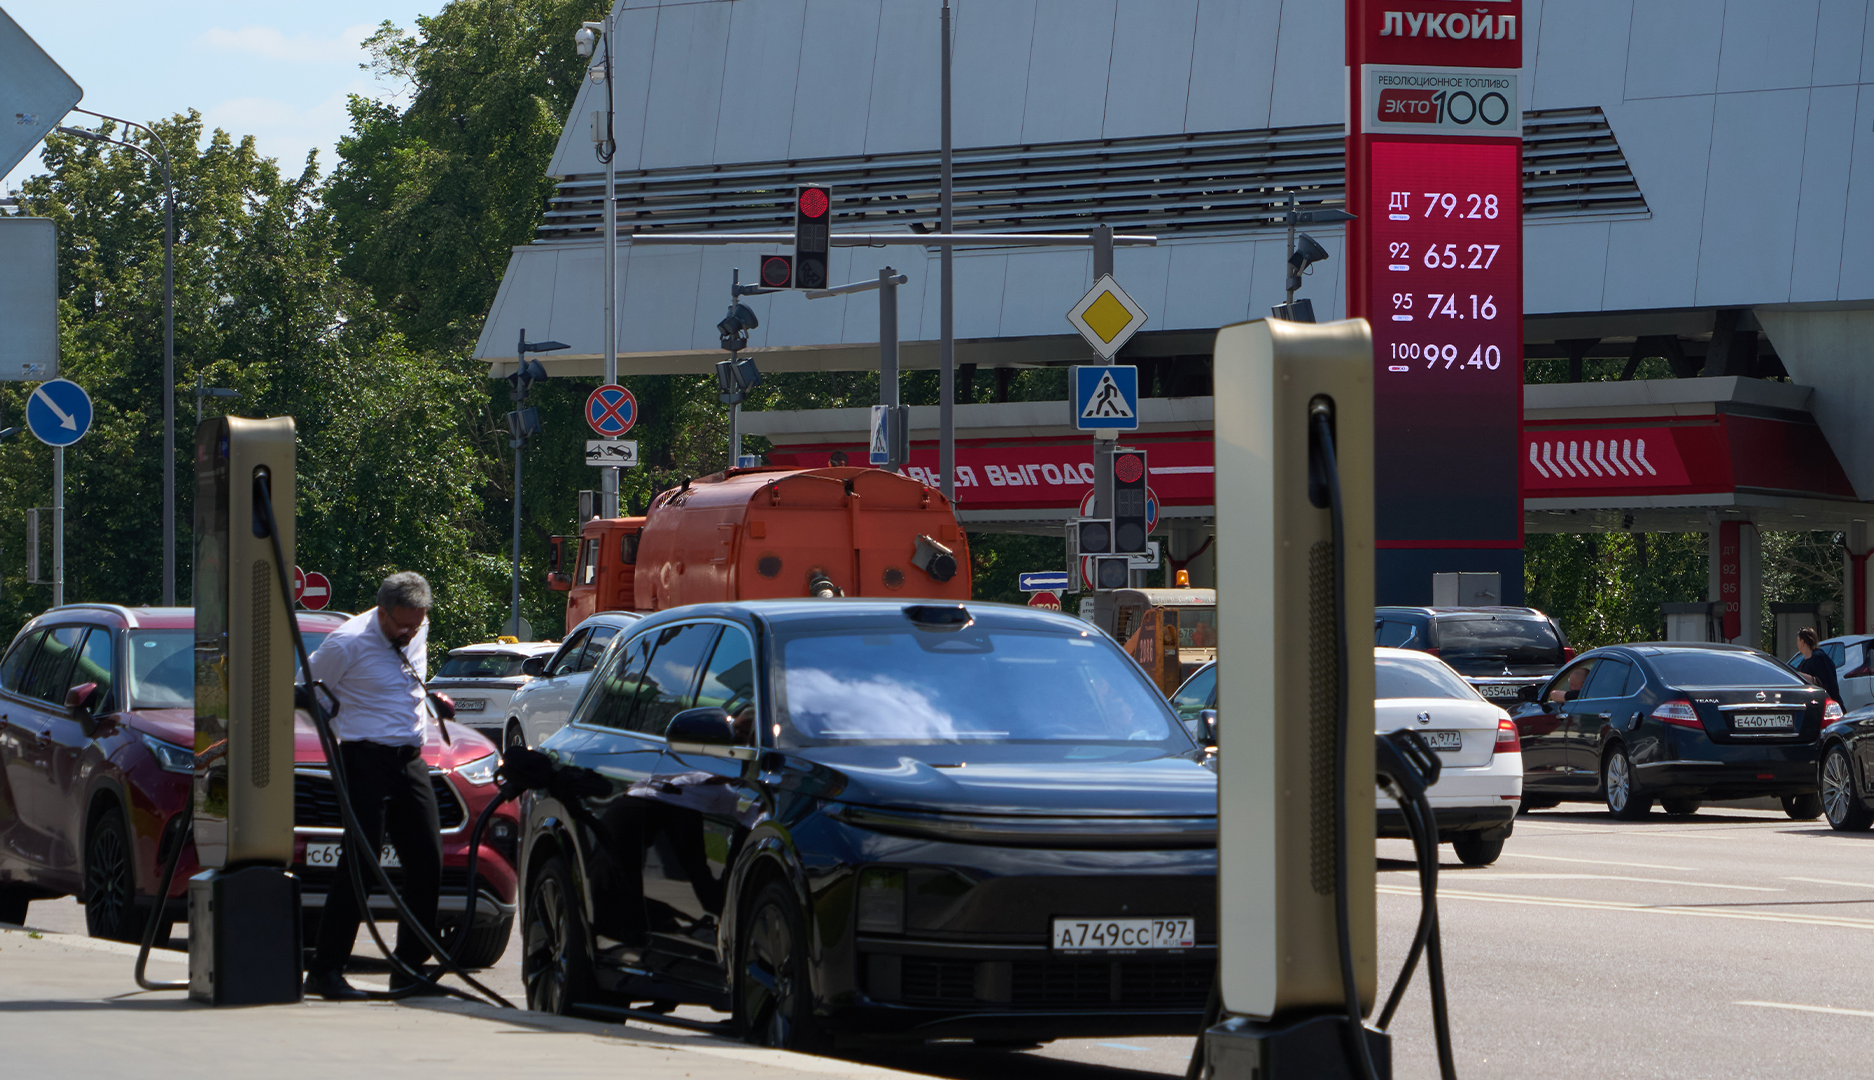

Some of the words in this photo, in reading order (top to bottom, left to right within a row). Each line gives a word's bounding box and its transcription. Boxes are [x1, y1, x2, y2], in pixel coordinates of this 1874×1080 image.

[1379, 8, 1516, 40] ЛУКОЙЛ
[1378, 75, 1463, 88] РЕВОЛЮЦИОННОЕ
[1465, 77, 1510, 89] ТОПЛИВО
[1385, 99, 1430, 114] ЭКТО
[1433, 90, 1509, 125] 100
[1388, 191, 1411, 211] ДТ
[1424, 193, 1499, 220] 79.28
[1389, 242, 1410, 259] 92
[1424, 243, 1500, 270] 65.27
[1392, 293, 1413, 310] 95
[1427, 293, 1497, 320] 74.16
[1391, 343, 1420, 360] 100
[1423, 344, 1501, 371] 99.40
[1723, 546, 1736, 555] ДТ
[1723, 564, 1736, 575] 92
[1722, 583, 1737, 593] 95
[1726, 602, 1739, 612] 00
[1736, 716, 1775, 727] Е440УТ
[1776, 715, 1791, 724] 197
[1438, 732, 1457, 742] 977
[1060, 923, 1150, 947] А749СС
[1154, 920, 1188, 939] 797
[1163, 939, 1180, 947] RUS
